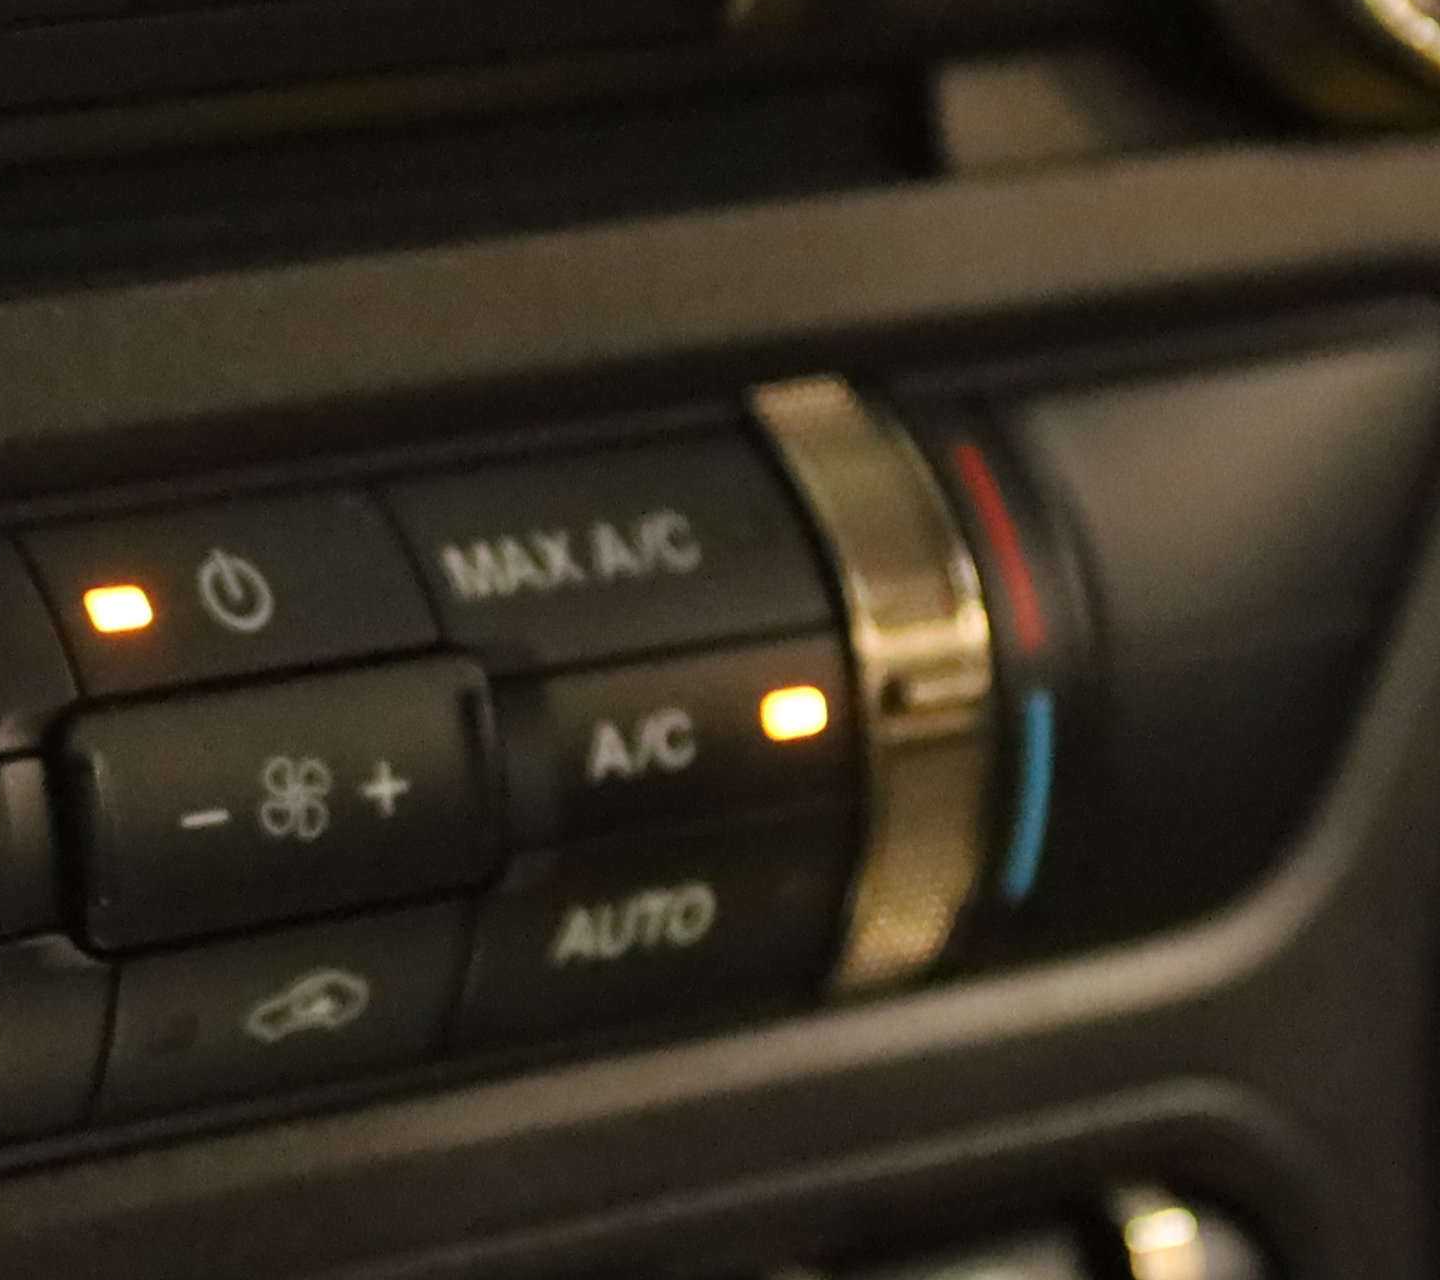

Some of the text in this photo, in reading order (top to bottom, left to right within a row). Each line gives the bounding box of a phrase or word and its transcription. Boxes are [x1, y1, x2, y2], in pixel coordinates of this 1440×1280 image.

[442, 510, 702, 600] MAX A/C
[586, 708, 697, 784] A/C
[554, 884, 715, 964] AUTO
